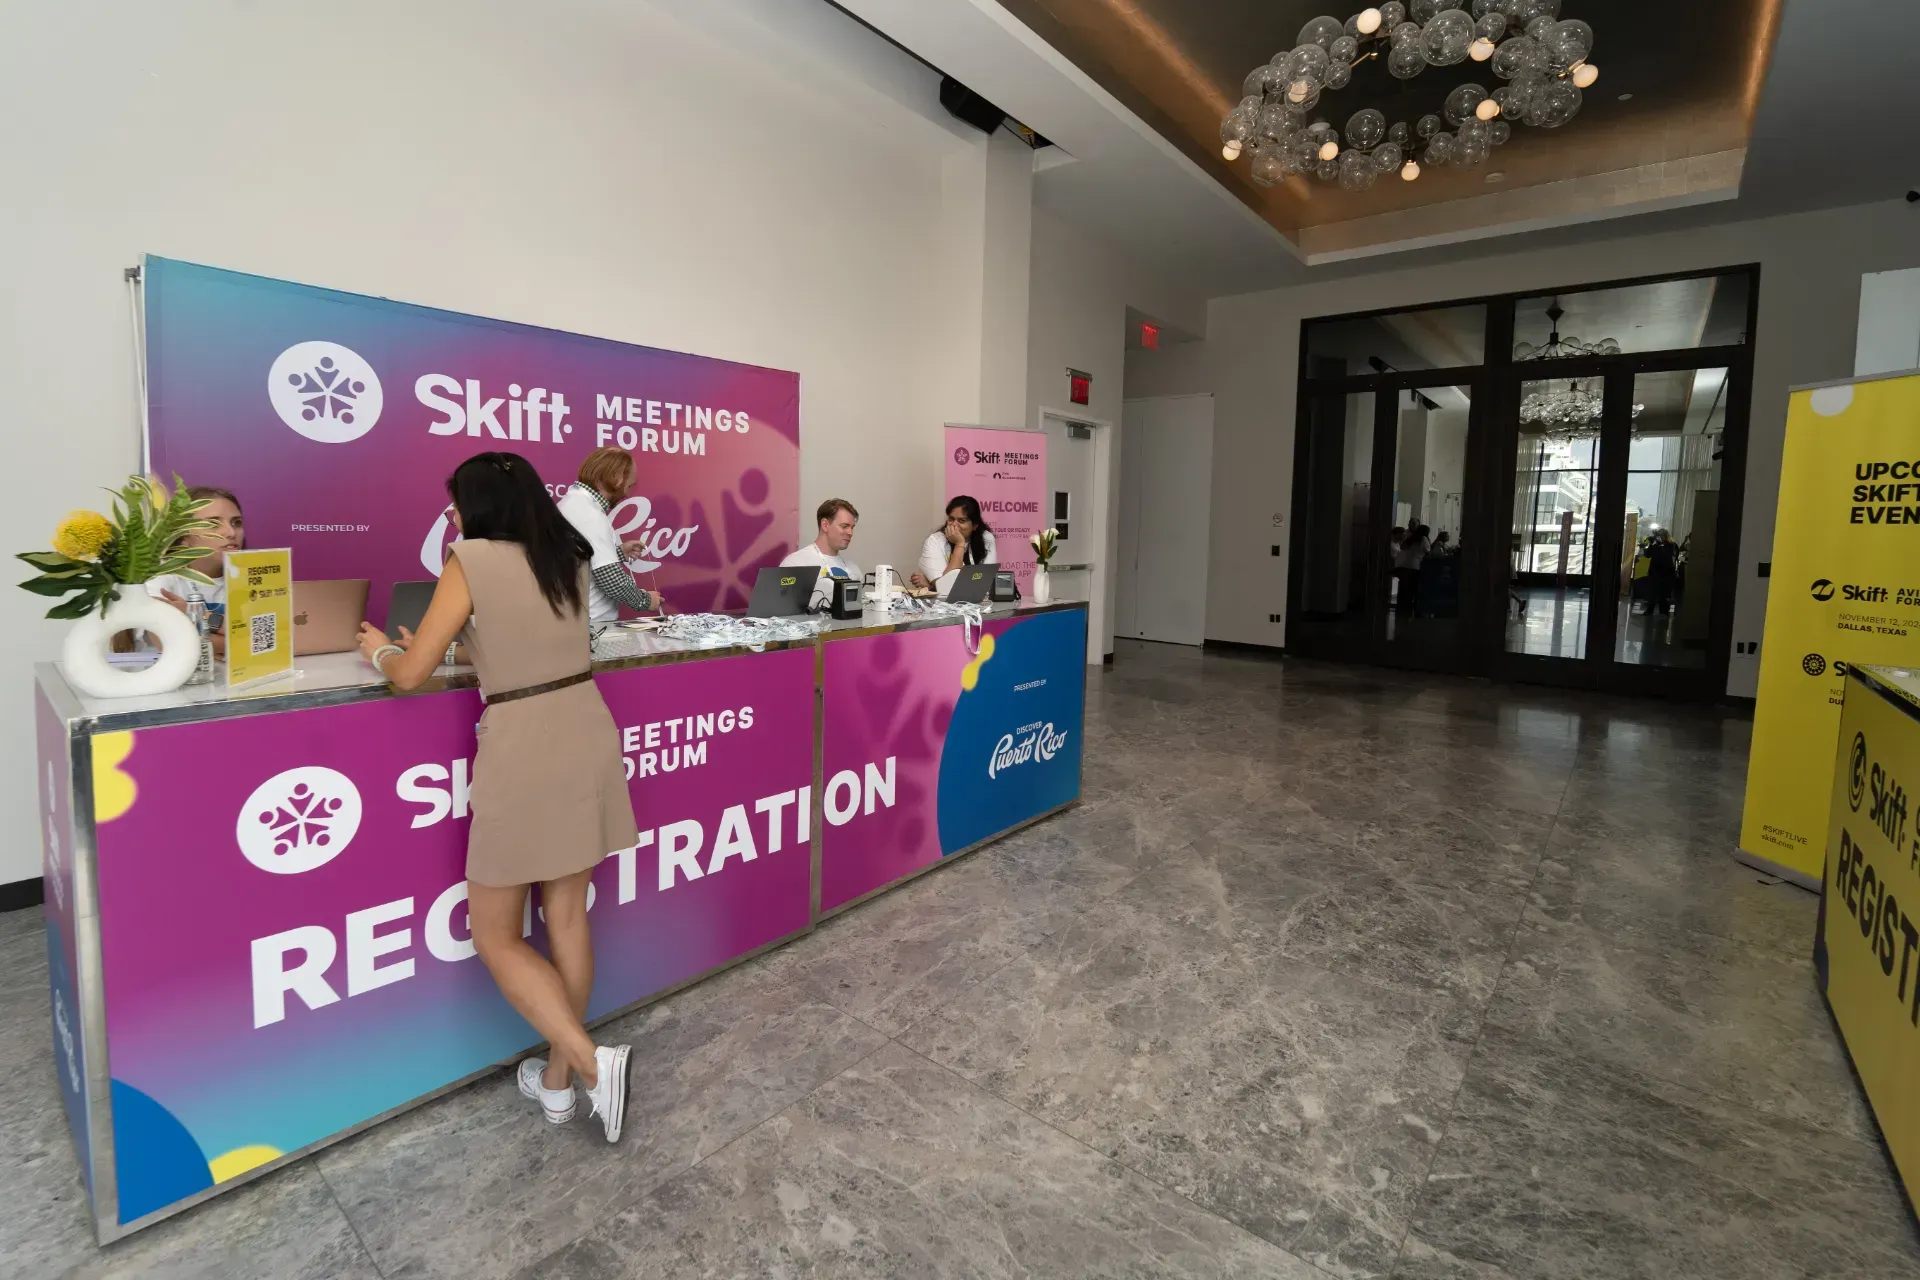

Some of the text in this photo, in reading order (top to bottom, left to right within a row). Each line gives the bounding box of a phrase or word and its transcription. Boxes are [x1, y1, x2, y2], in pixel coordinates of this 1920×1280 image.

[595, 393, 750, 434] MEETINGS
[596, 422, 706, 456] FORUM
[1004, 452, 1039, 461] MEETINGS
[1853, 484, 1920, 502] SKIFT
[980, 501, 1039, 513] WELCOME
[291, 524, 370, 532] PRESENTED BY
[248, 565, 281, 576] REGISTER
[1018, 569, 1032, 577] APP
[248, 576, 263, 586] FOR
[1839, 613, 1887, 625] NOVEMBER
[1902, 619, 1920, 628] 202
[1837, 622, 1907, 636] DALLAS, TEXAS
[1013, 680, 1040, 692] PRESENTED
[617, 706, 754, 752] EETINGS
[1016, 721, 1042, 735] DISCOVER
[988, 722, 1068, 780] Puerto Rico
[622, 741, 707, 781] ORUM
[1761, 834, 1794, 850] skift.com
[1763, 825, 1808, 845] #SKIFTLIVE
[251, 757, 896, 1030] REGTRATION
